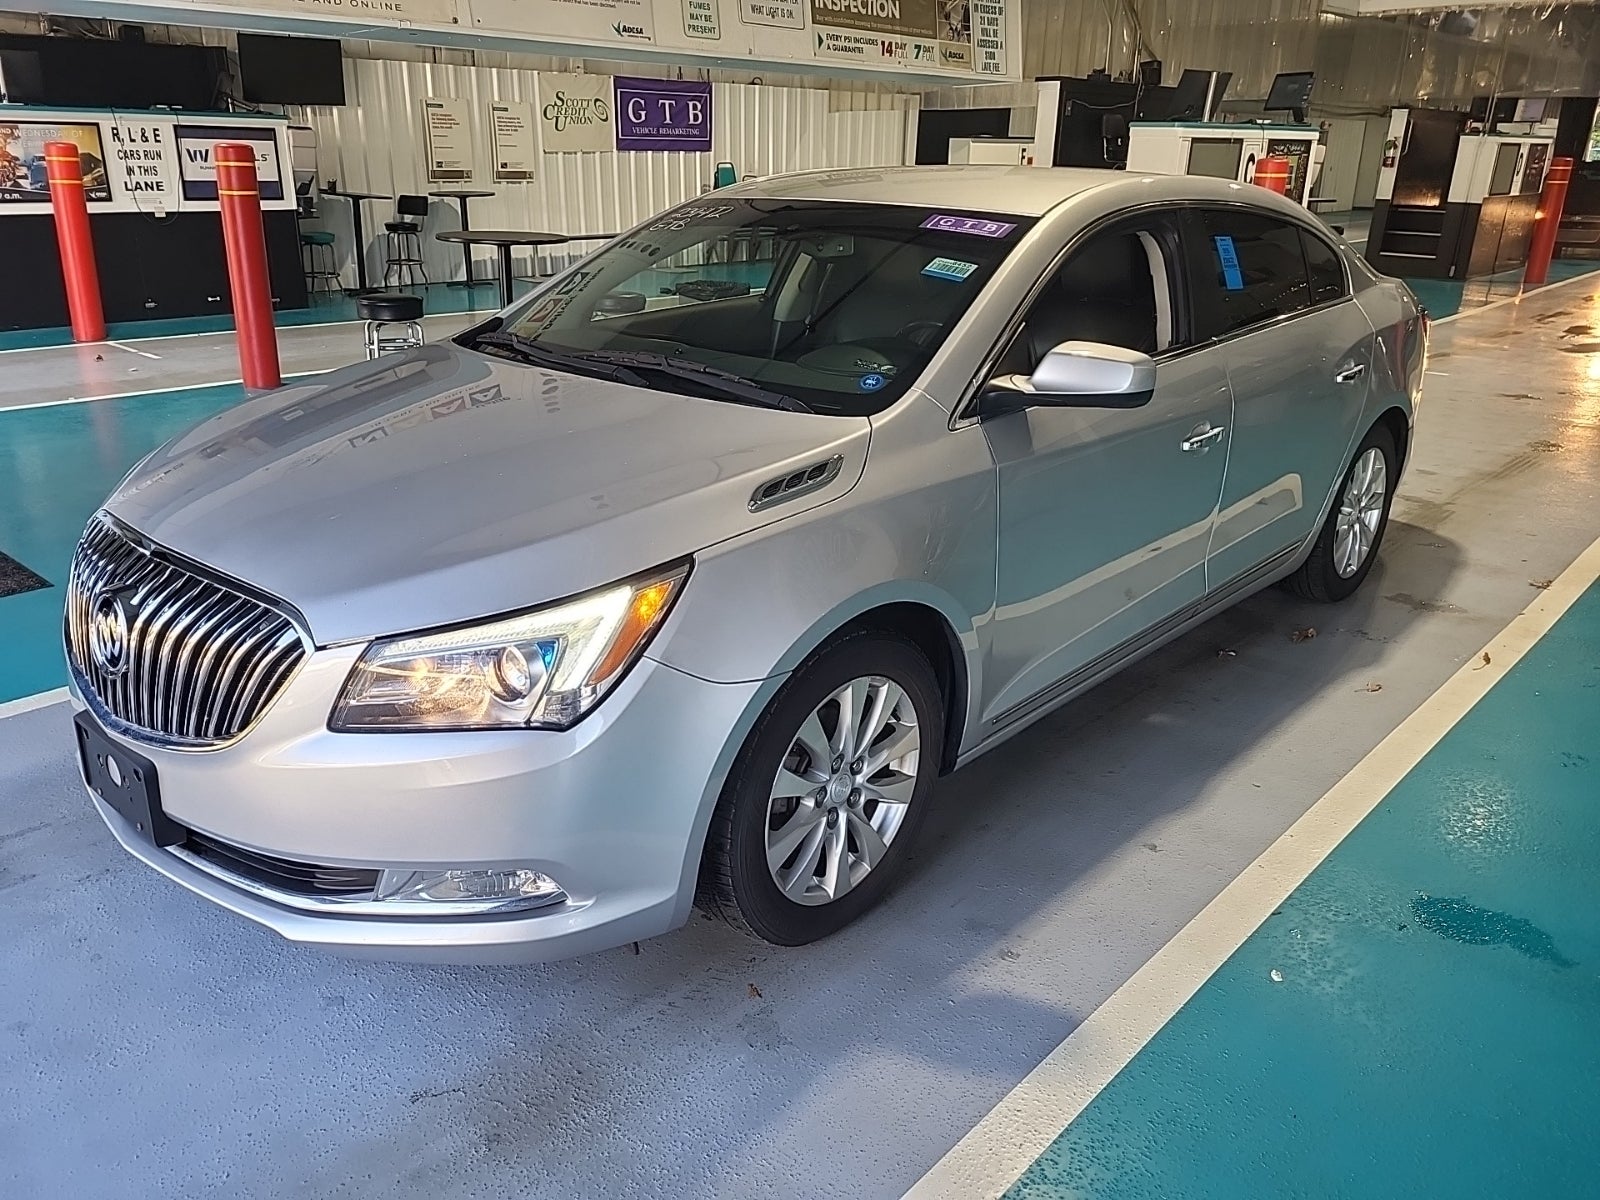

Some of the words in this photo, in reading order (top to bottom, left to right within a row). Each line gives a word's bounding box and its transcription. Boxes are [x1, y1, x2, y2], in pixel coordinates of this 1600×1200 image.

[349, 0, 403, 12] ONLINE
[688, 1, 711, 11] FUMES
[750, 4, 765, 16] WHAT
[766, 6, 780, 18] LIGHT
[780, 8, 786, 18] IS
[689, 12, 703, 21] MAY
[704, 14, 713, 23] BE
[687, 23, 717, 35] PRESENT
[825, 33, 842, 42] EVERY
[843, 35, 852, 43] PSI
[853, 37, 878, 47] INCLUDES
[826, 43, 831, 51] A
[832, 44, 864, 54] GUARANTEE
[880, 40, 893, 57] 14
[894, 42, 907, 51] DAY
[894, 50, 908, 59] FULL
[913, 44, 922, 60] 7
[922, 44, 935, 54] DAY
[922, 53, 935, 62] FULL
[981, 61, 992, 72] LATE
[992, 62, 1001, 73] FEE
[554, 90, 592, 107] SCOTT
[543, 104, 587, 120] CREDIT
[553, 115, 594, 132] UNION
[12, 128, 69, 137] WEDNESDA
[127, 127, 137, 143] L
[140, 127, 150, 143] &
[152, 128, 162, 144] E
[632, 126, 657, 135] VEHICLE
[659, 127, 700, 136] REMARKETING
[117, 149, 142, 161] CARS
[143, 149, 162, 161] RUN
[125, 165, 136, 177] IN
[137, 165, 159, 177] THIS
[124, 181, 165, 192] LANE
